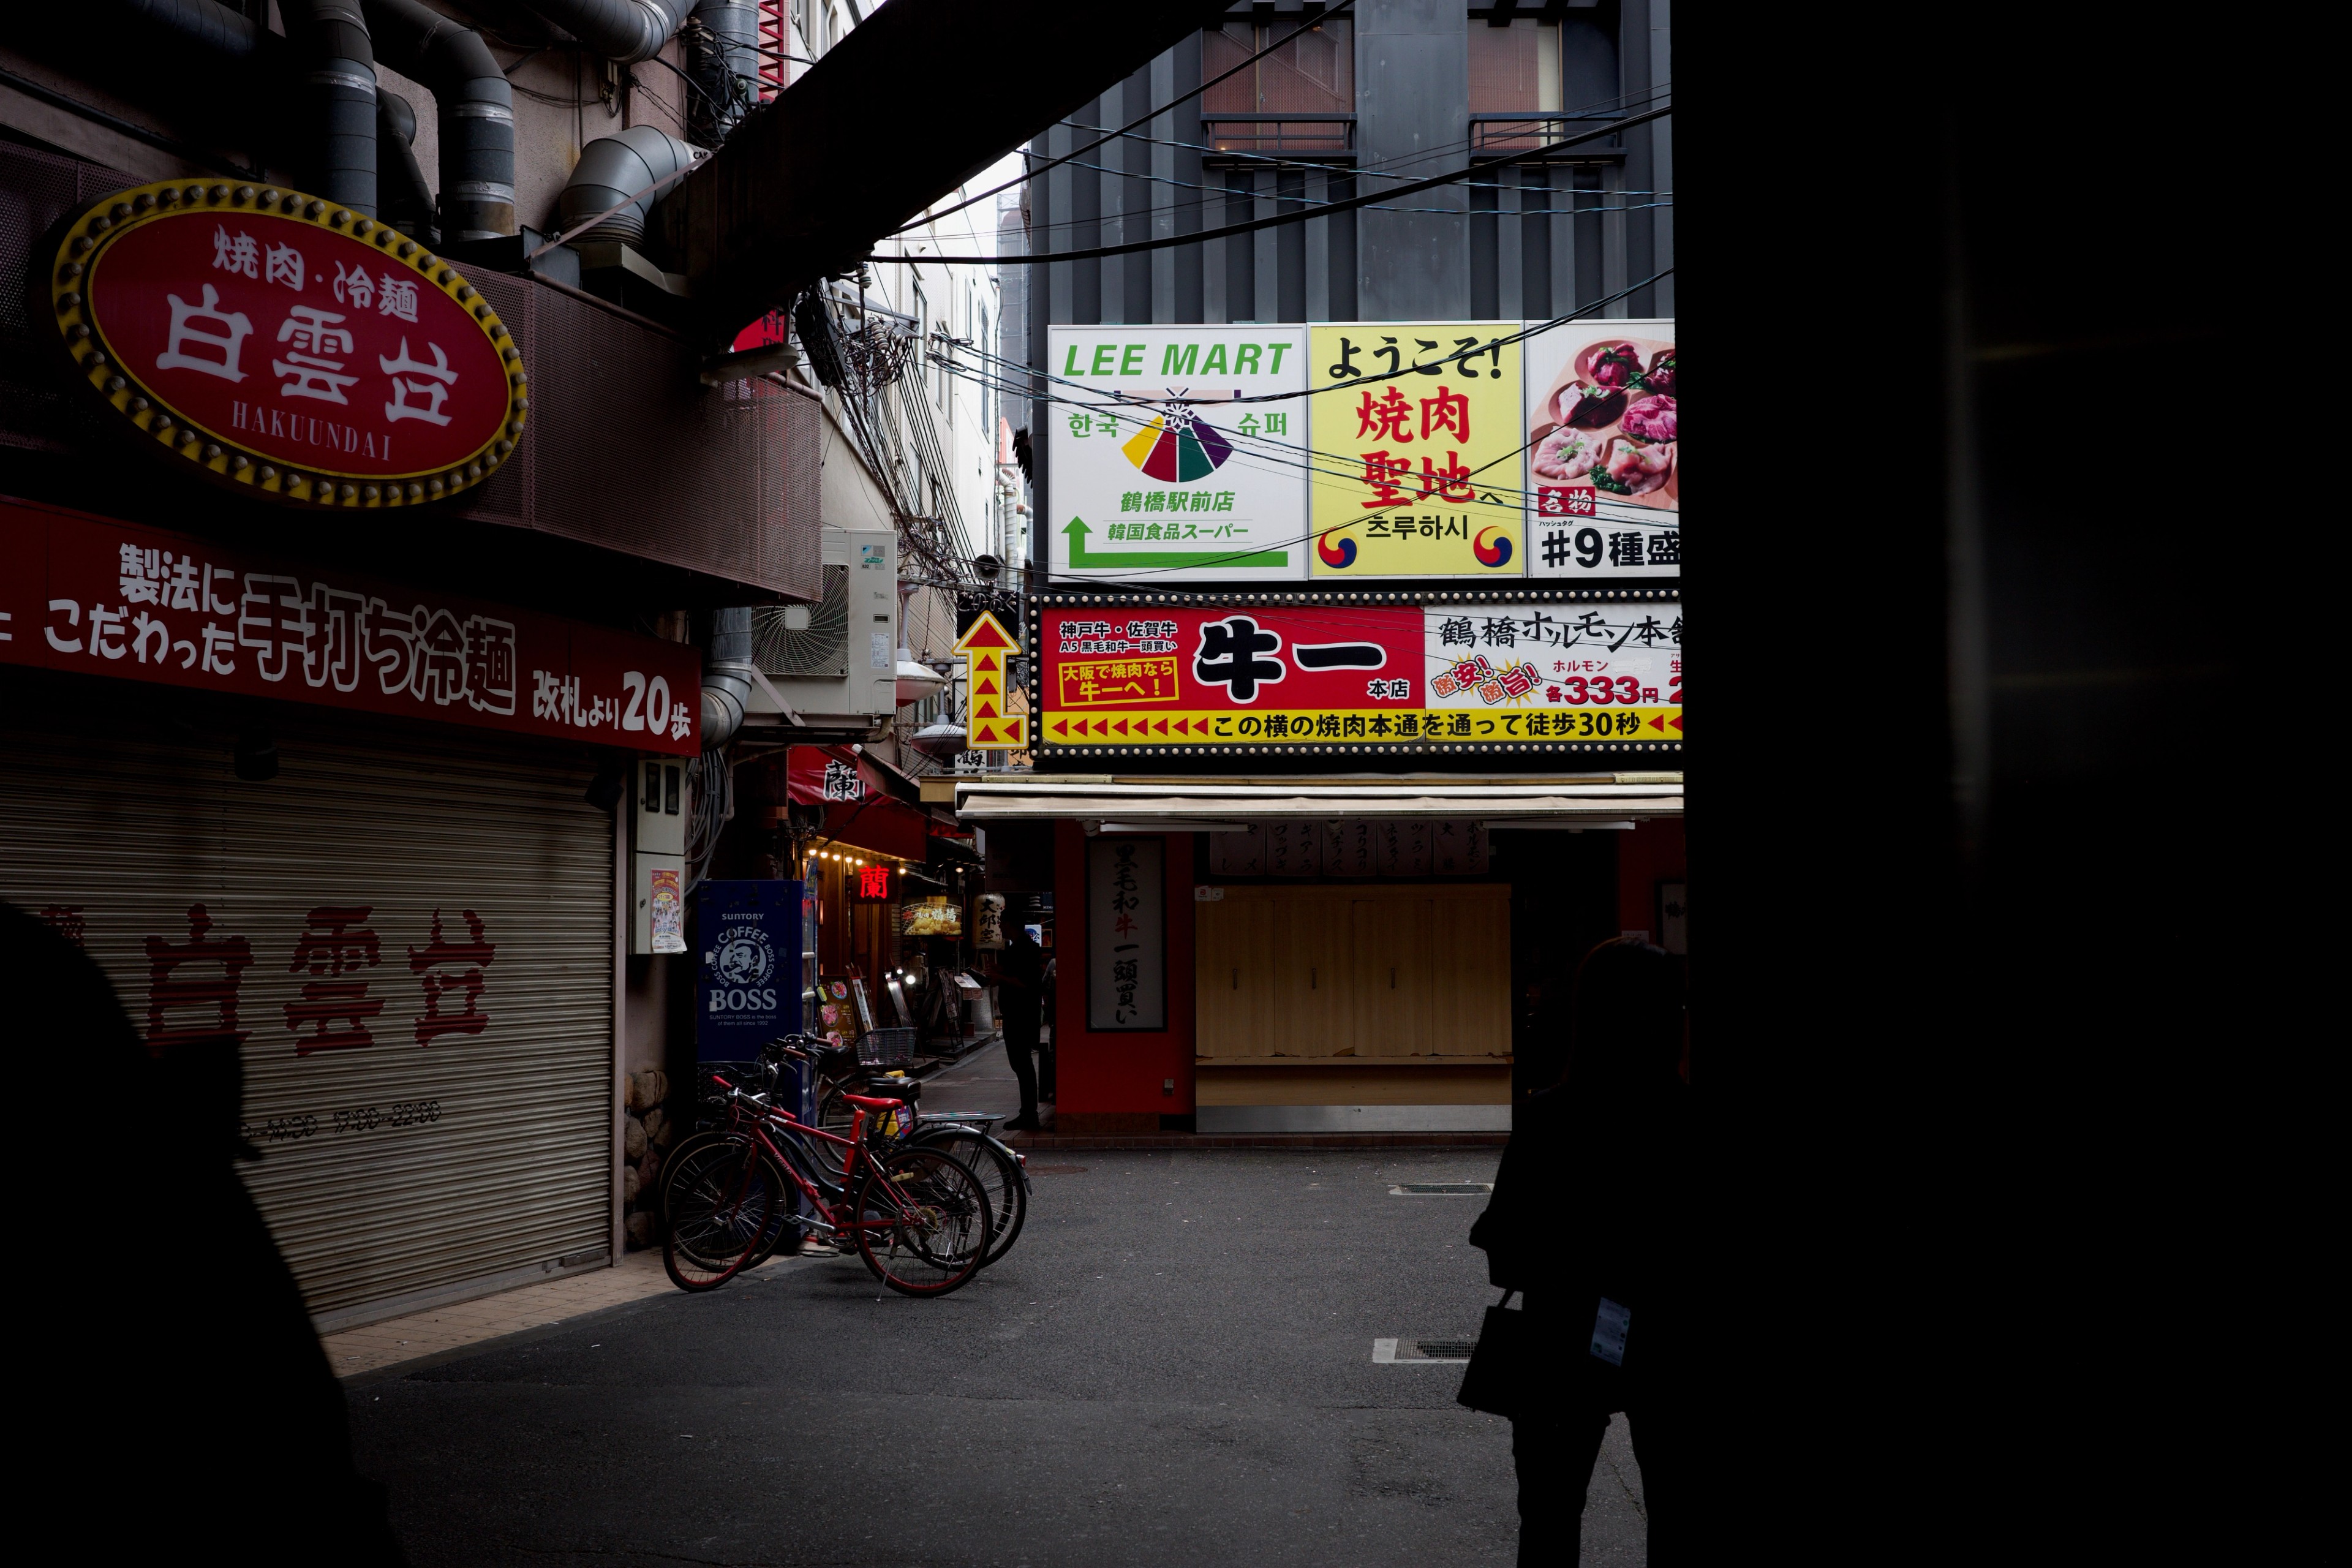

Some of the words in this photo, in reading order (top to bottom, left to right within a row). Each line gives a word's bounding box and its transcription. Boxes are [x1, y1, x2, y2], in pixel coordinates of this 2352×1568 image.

[213, 222, 420, 324] 焼肉・冷麺
[155, 282, 459, 428] 白雲台
[1063, 344, 1147, 376] LEE
[1161, 342, 1292, 376] MART
[1068, 413, 1120, 438] 한국
[1237, 412, 1287, 436] 슈퍼
[1355, 385, 1470, 444] 焼肉
[232, 400, 393, 461] HAKUUNDAI
[1120, 491, 1235, 513] 鶴橋駅前店
[1540, 489, 1593, 513] 名物
[1107, 523, 1249, 541] 韓国食品スーパー
[1365, 514, 1469, 540] 츠루하시
[119, 542, 236, 616] 製法に
[44, 598, 236, 676] こだわった
[1060, 620, 1178, 639] 神戸牛・佐賀牛
[238, 572, 517, 717] 手打ち冷麺
[1080, 641, 1177, 654] 黒毛和牛一頭買い
[1063, 661, 1173, 682] 大阪で焼肉なら
[1192, 615, 1387, 704] 牛一
[1553, 660, 1608, 673] ホルモン
[1366, 677, 1411, 700] 本店
[532, 669, 692, 742] 改札より20歩
[1213, 712, 1642, 739] この横の焼肉本通を通って徒歩30秒
[858, 864, 890, 900] 蘭
[718, 925, 769, 944] COFFEE
[1112, 843, 1140, 1024] 黒毛和牛一頭買い
[764, 944, 775, 962] BOSS
[142, 903, 497, 1059] 白雲台
[714, 971, 730, 987] BOSS
[756, 963, 774, 987] COFFEE
[709, 989, 777, 1011] BOSS
